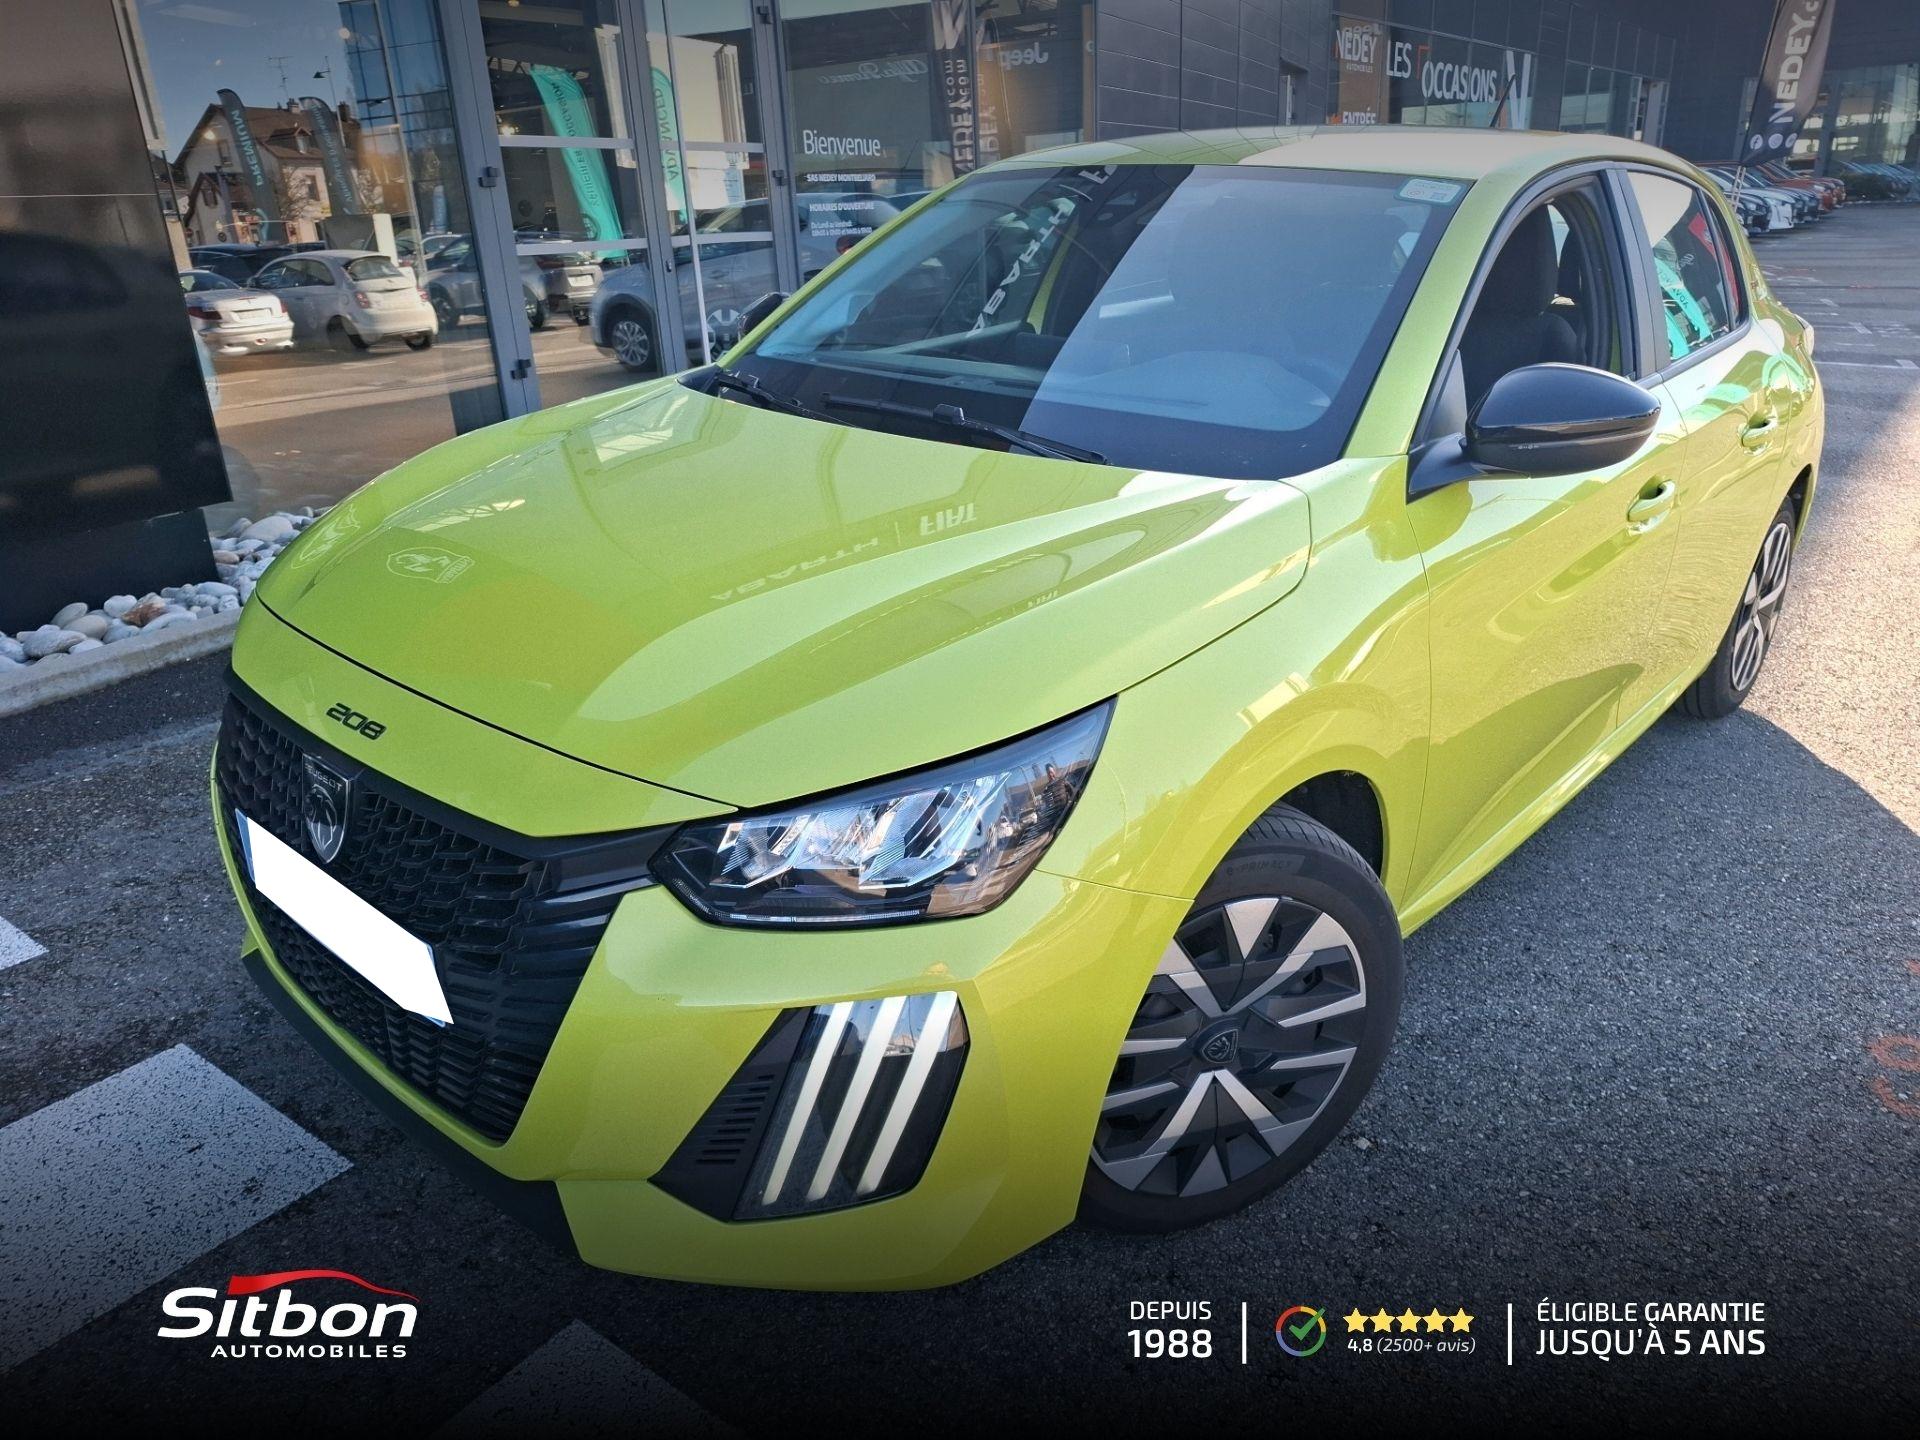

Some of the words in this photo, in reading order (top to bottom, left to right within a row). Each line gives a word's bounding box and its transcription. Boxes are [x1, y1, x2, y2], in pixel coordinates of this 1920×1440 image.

[1335, 29, 1377, 64] NEDEY
[1386, 39, 1412, 79] LES
[1421, 60, 1497, 103] OCCASIONS
[802, 129, 881, 156] Bienvenue
[806, 173, 818, 182] SAS
[819, 173, 837, 181] NEDEY
[326, 702, 387, 741] 208
